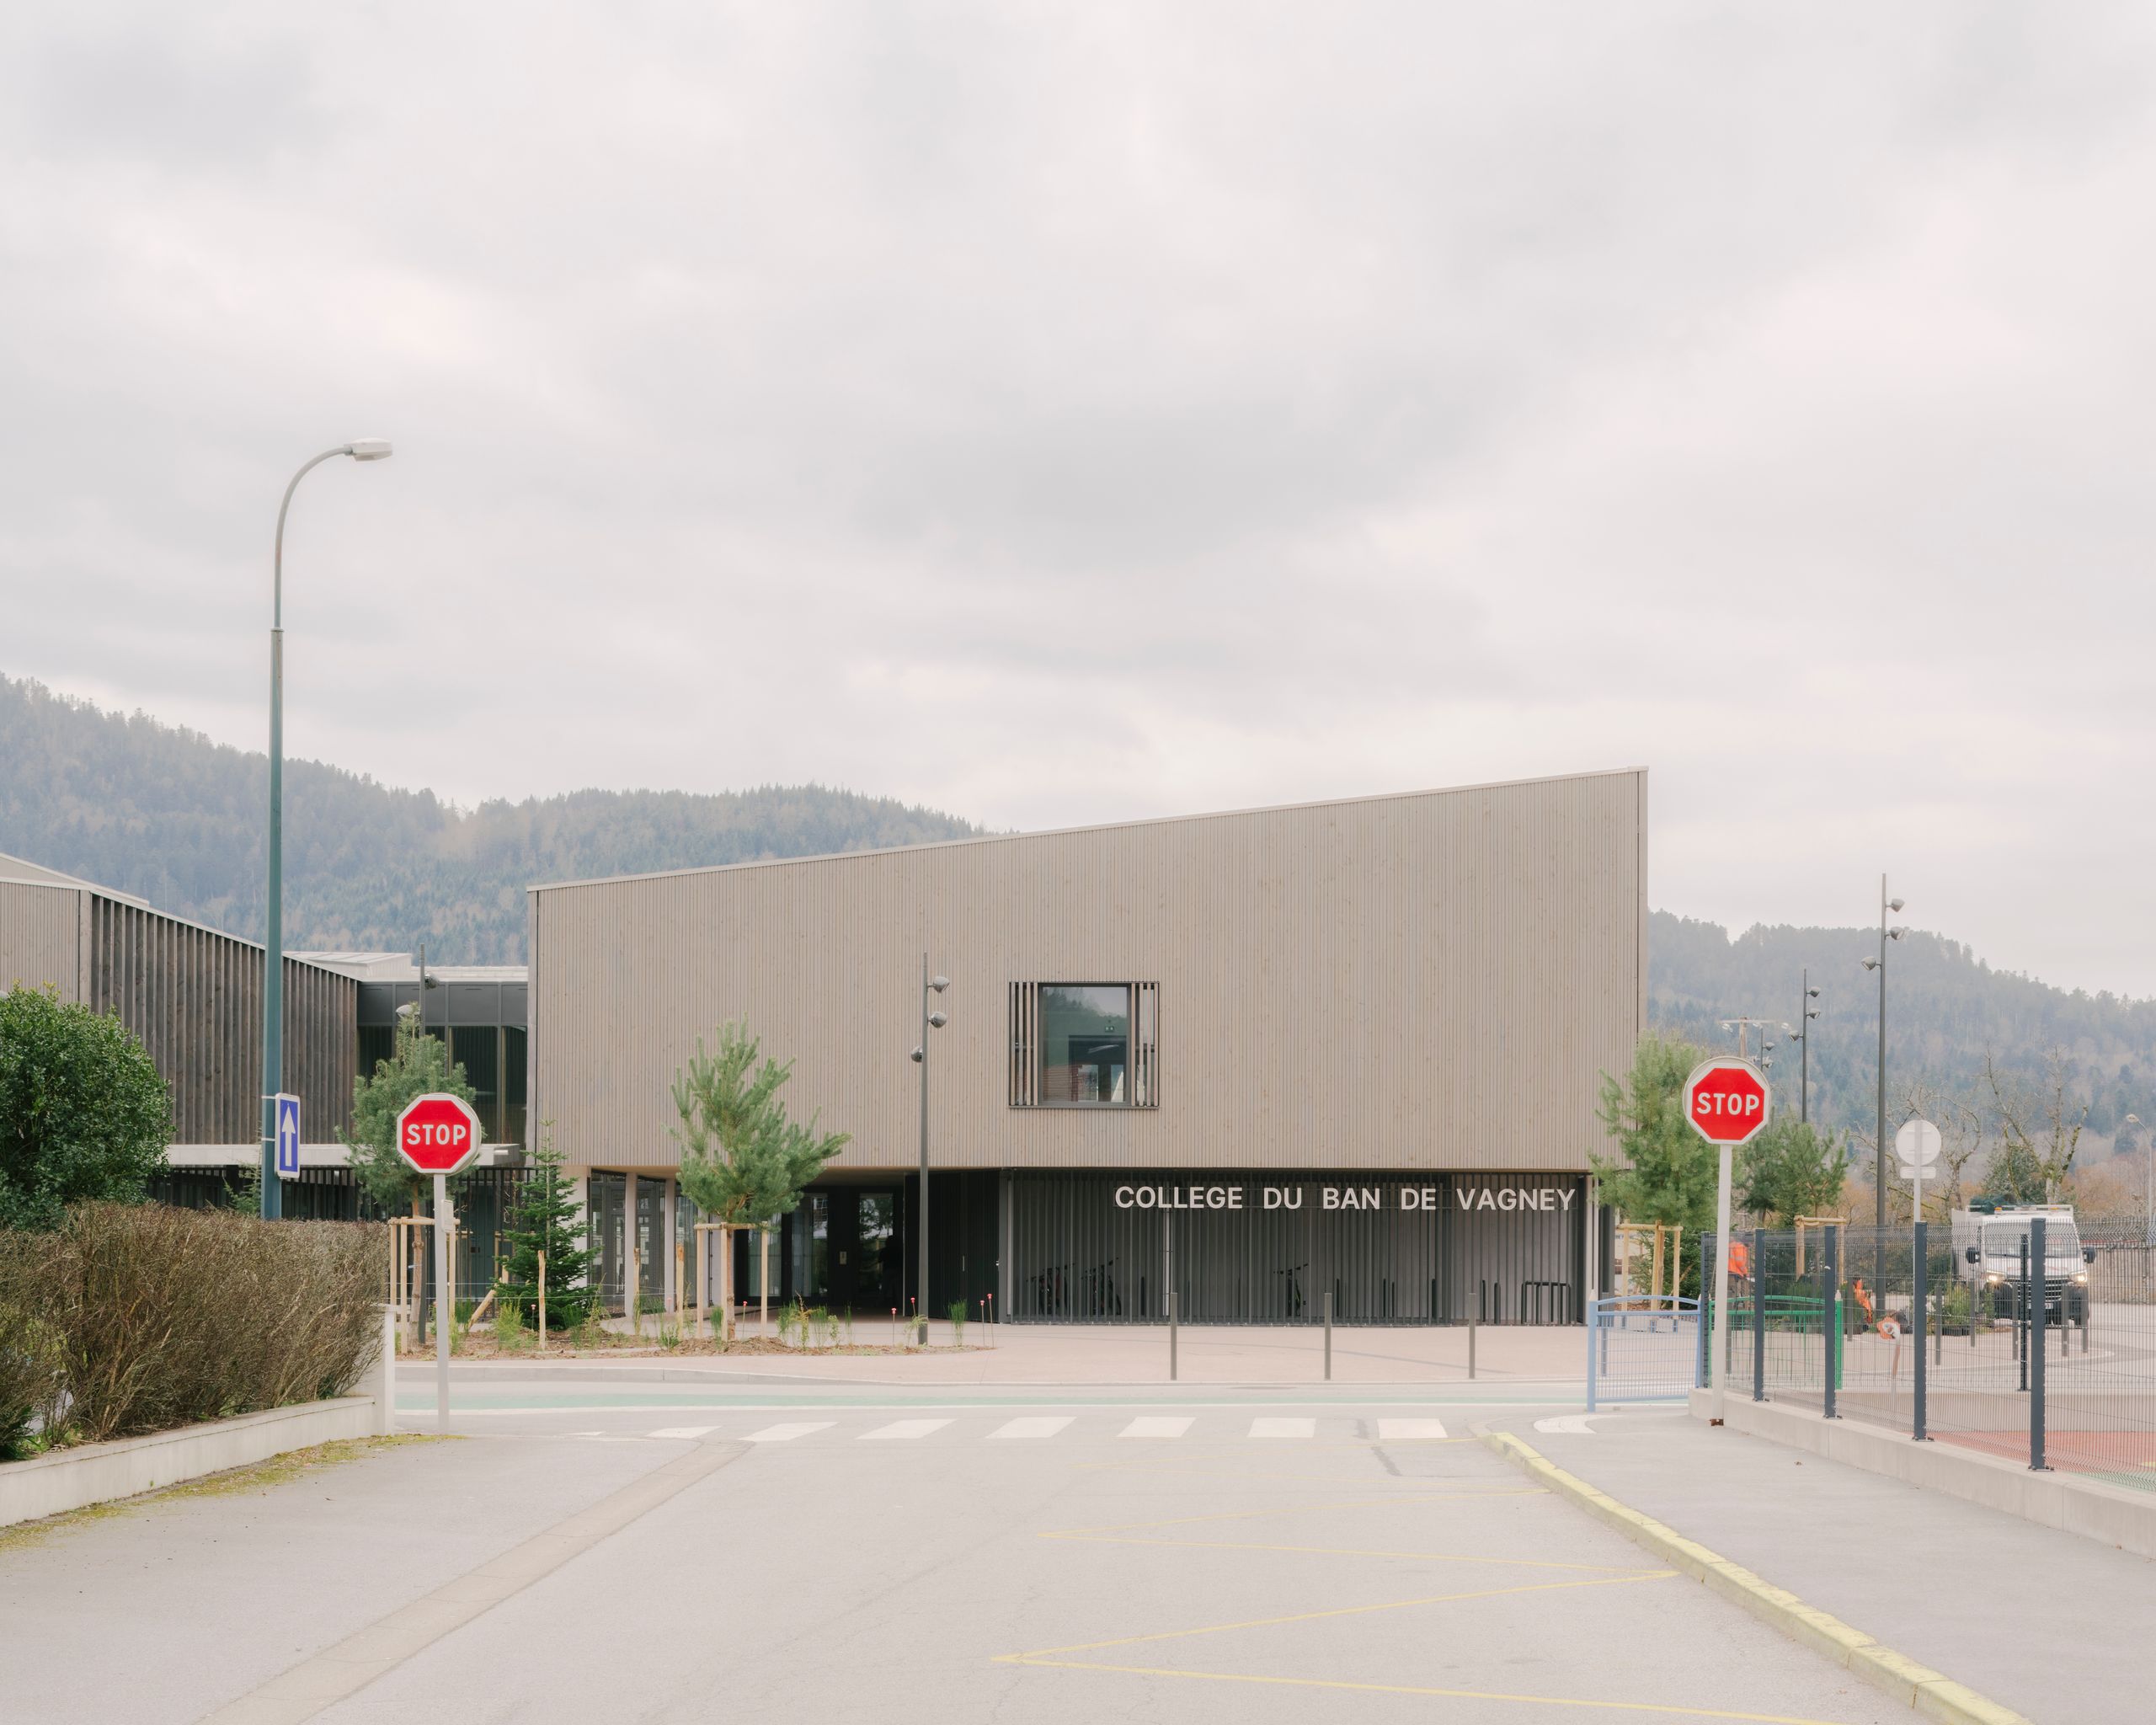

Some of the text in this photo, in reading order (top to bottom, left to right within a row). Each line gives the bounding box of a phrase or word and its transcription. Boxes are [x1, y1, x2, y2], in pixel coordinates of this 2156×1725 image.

[1696, 1092, 1760, 1117] STOP
[406, 1124, 467, 1146] STOP
[1115, 1186, 1576, 1212] COLLEGE DU BAN DE VAGNEY
